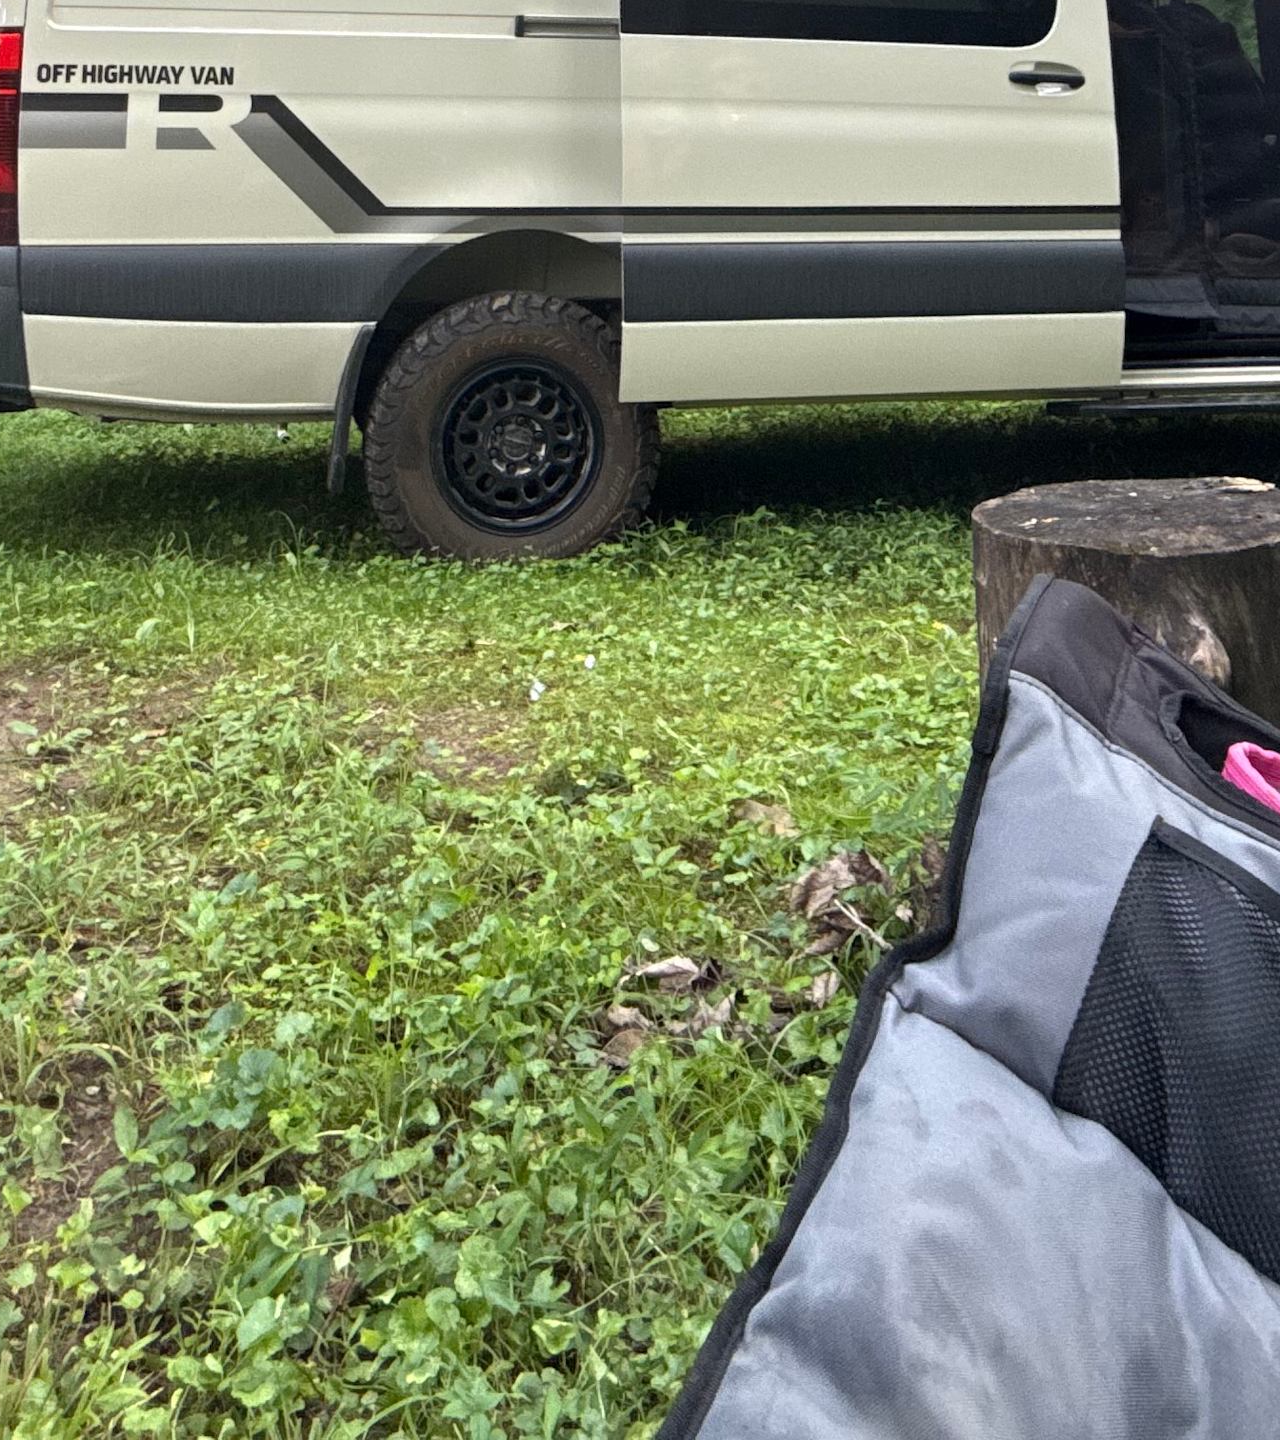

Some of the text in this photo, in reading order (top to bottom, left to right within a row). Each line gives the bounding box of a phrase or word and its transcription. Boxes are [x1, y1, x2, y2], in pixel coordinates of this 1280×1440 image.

[36, 63, 235, 86] OFF HIGHWAY VAN
